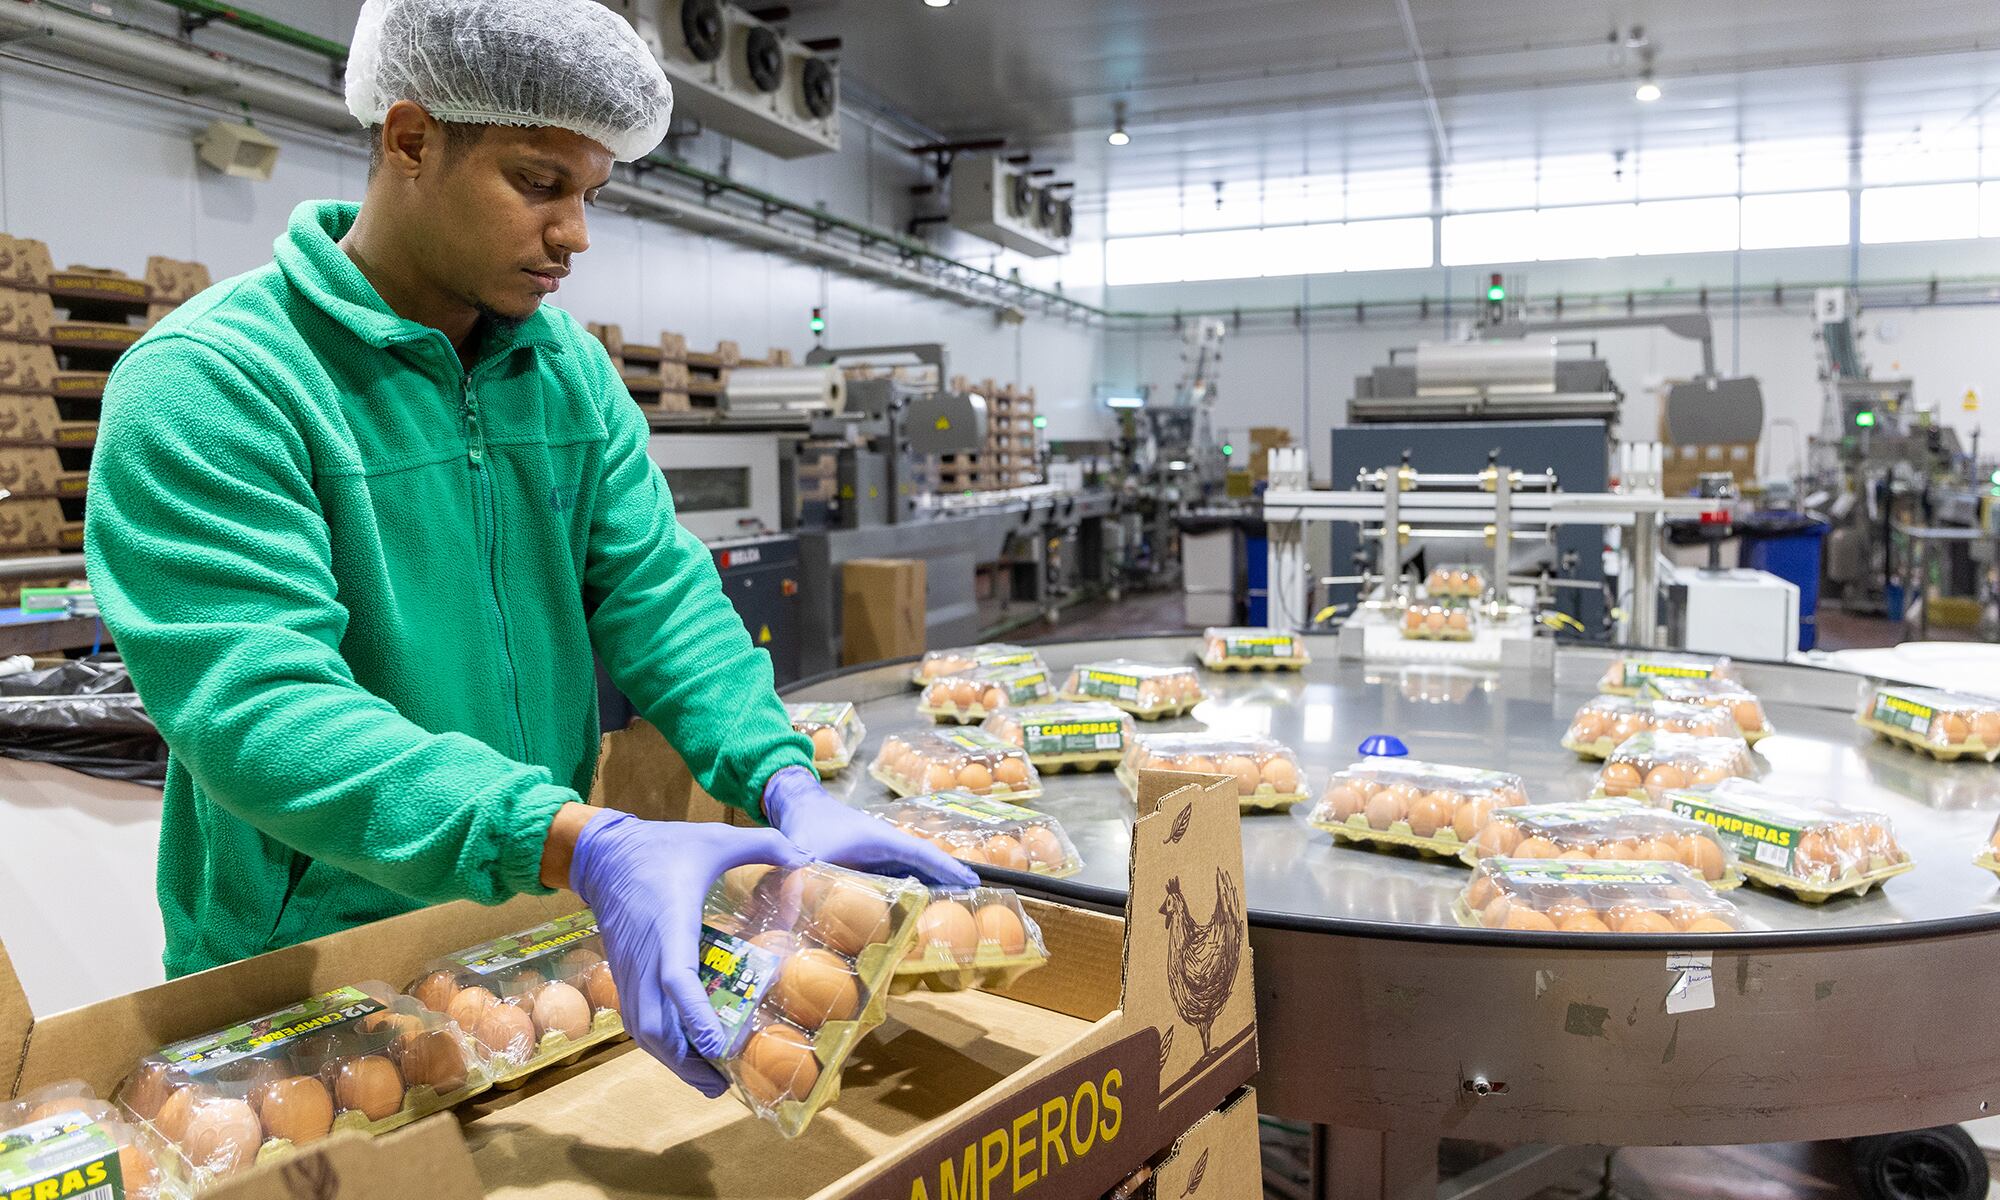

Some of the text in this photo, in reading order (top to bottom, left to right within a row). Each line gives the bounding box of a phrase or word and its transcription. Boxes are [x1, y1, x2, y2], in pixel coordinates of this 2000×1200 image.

[1025, 721, 1118, 737] 12 CAMPERAS
[1675, 803, 1693, 820] 12
[1694, 809, 1791, 847] CAMPERAS
[247, 1000, 377, 1050] 12 CAMPERAS
[0, 1161, 108, 1200] ERAS
